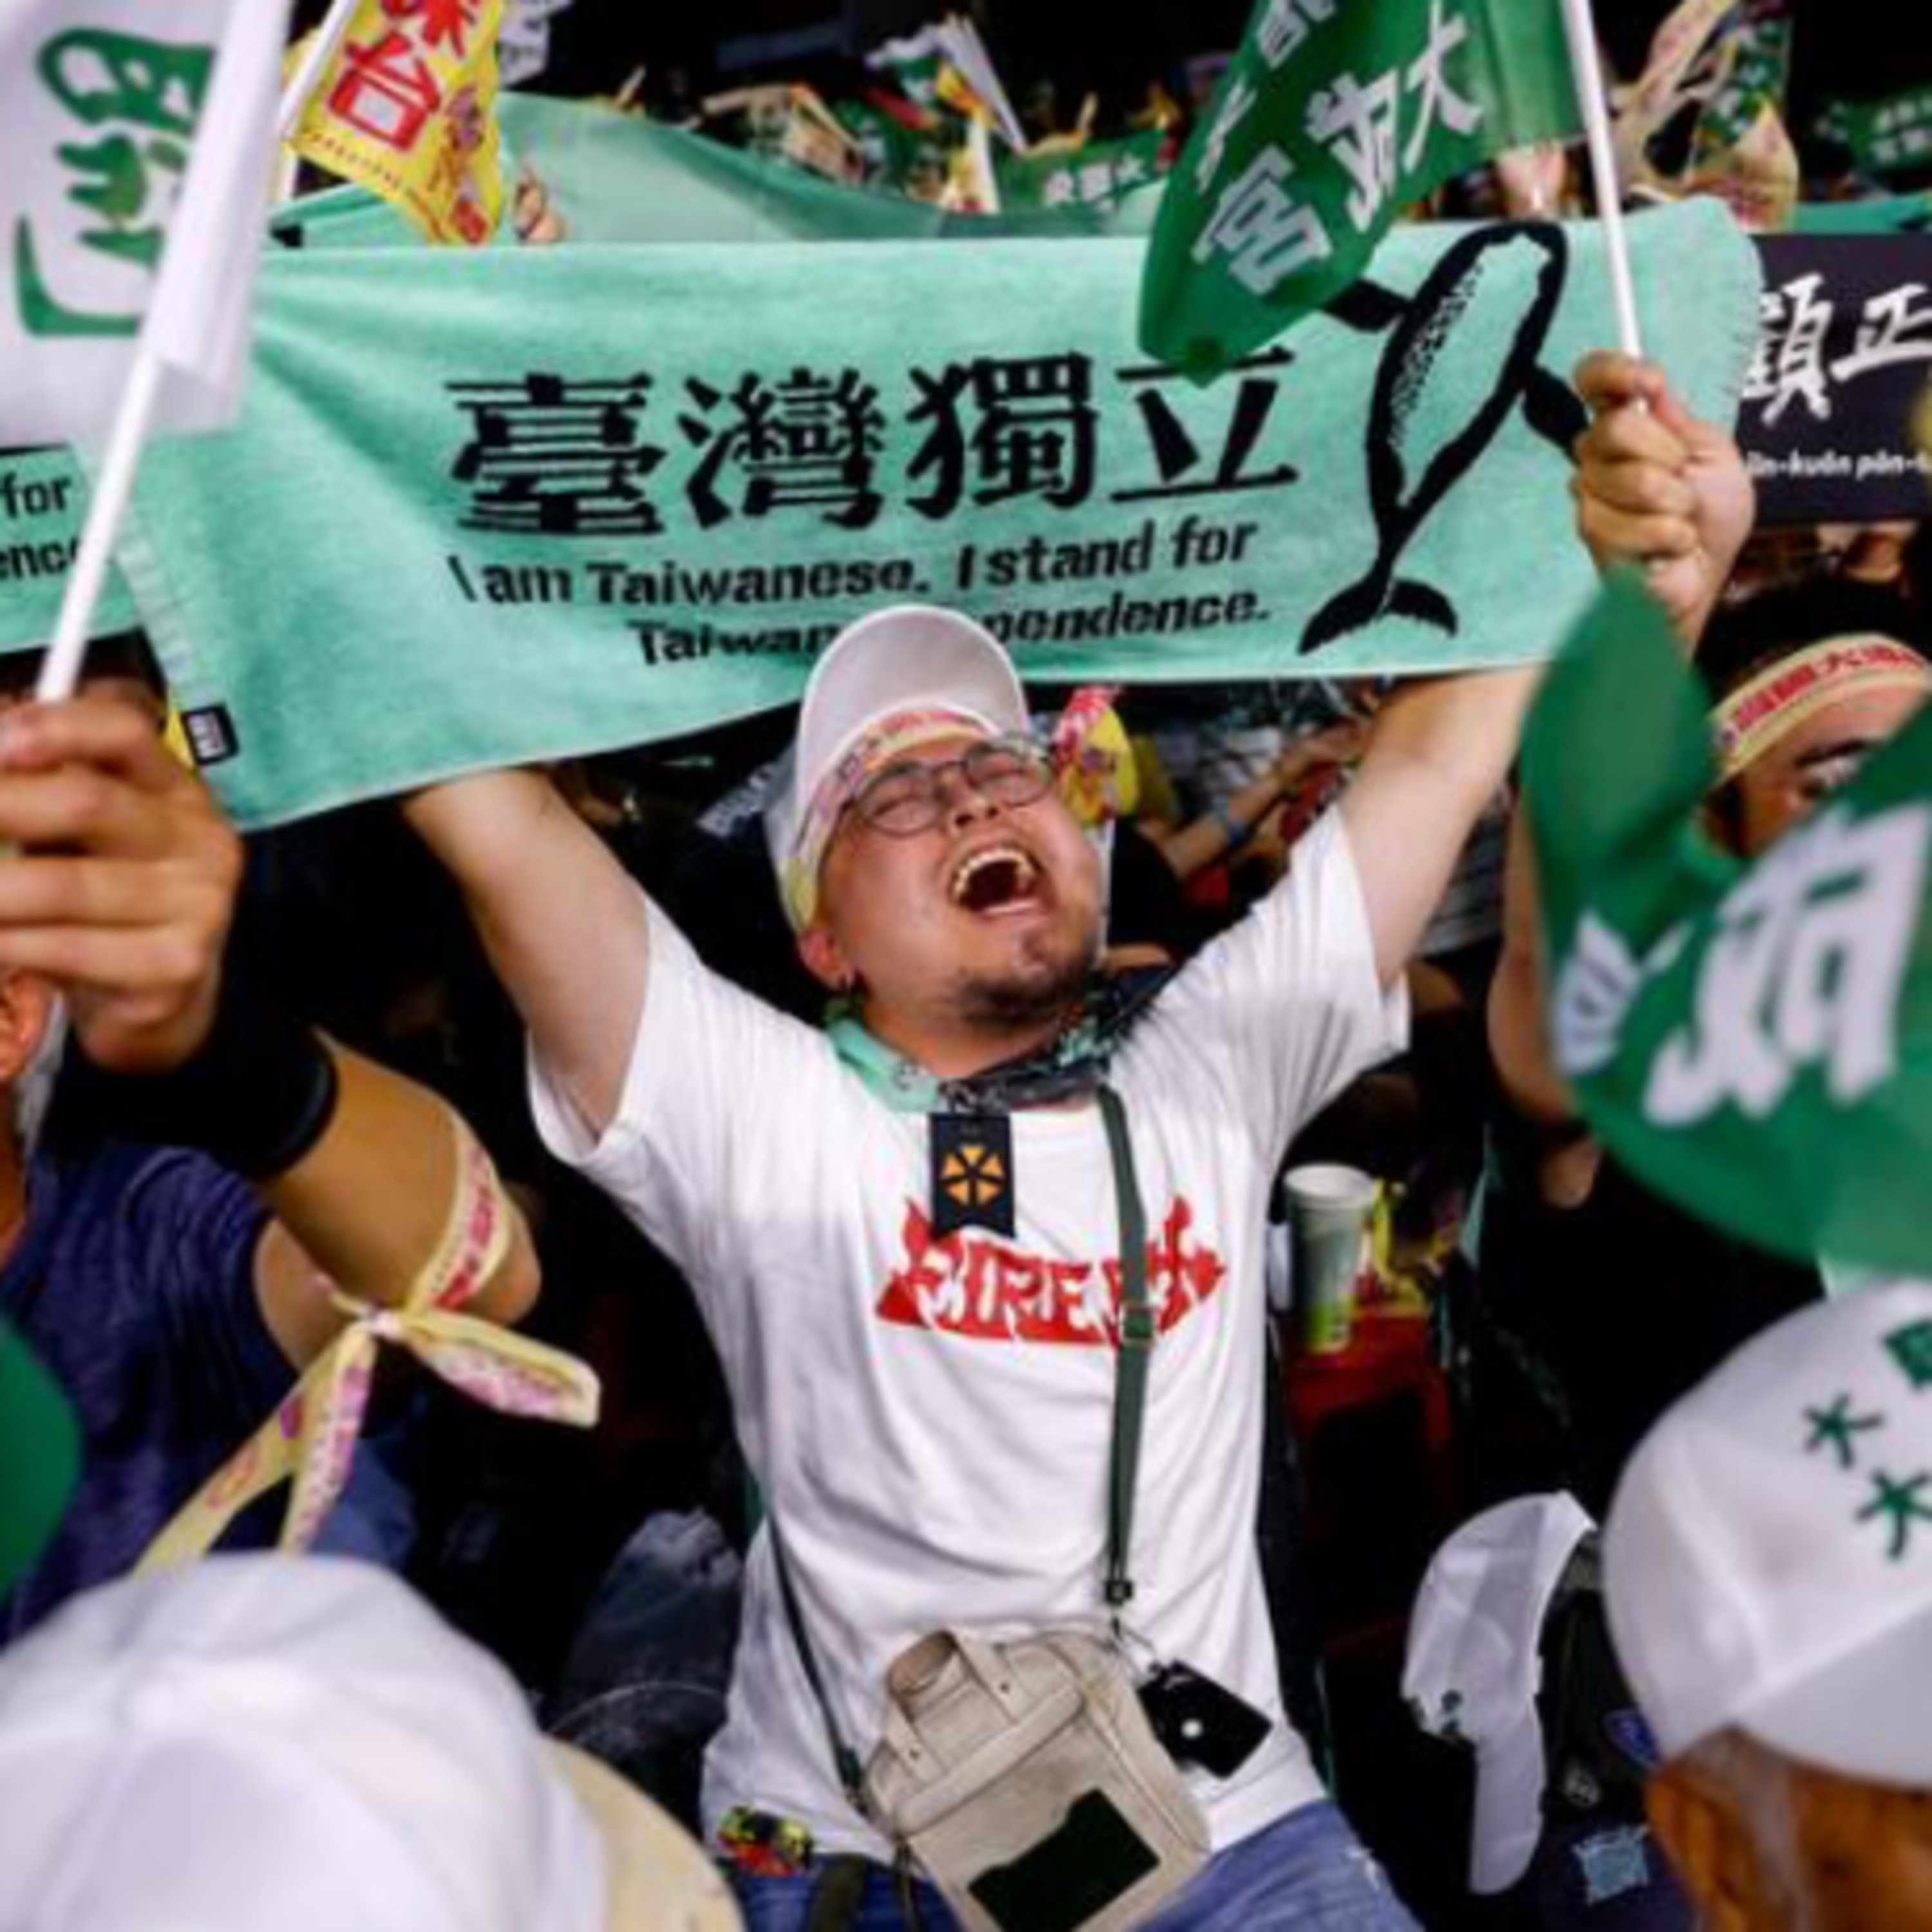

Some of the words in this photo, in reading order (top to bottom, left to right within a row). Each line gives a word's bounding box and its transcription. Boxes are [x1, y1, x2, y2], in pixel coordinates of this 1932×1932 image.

[444, 348, 1300, 536] 臺灣獨立
[0, 472, 71, 519] for
[447, 555, 477, 602] I
[480, 563, 572, 603] am
[585, 559, 929, 605] Taiwanese.
[958, 545, 974, 589] I
[985, 518, 1155, 587] stand
[1171, 515, 1258, 568] for
[950, 591, 1270, 643] pendence.
